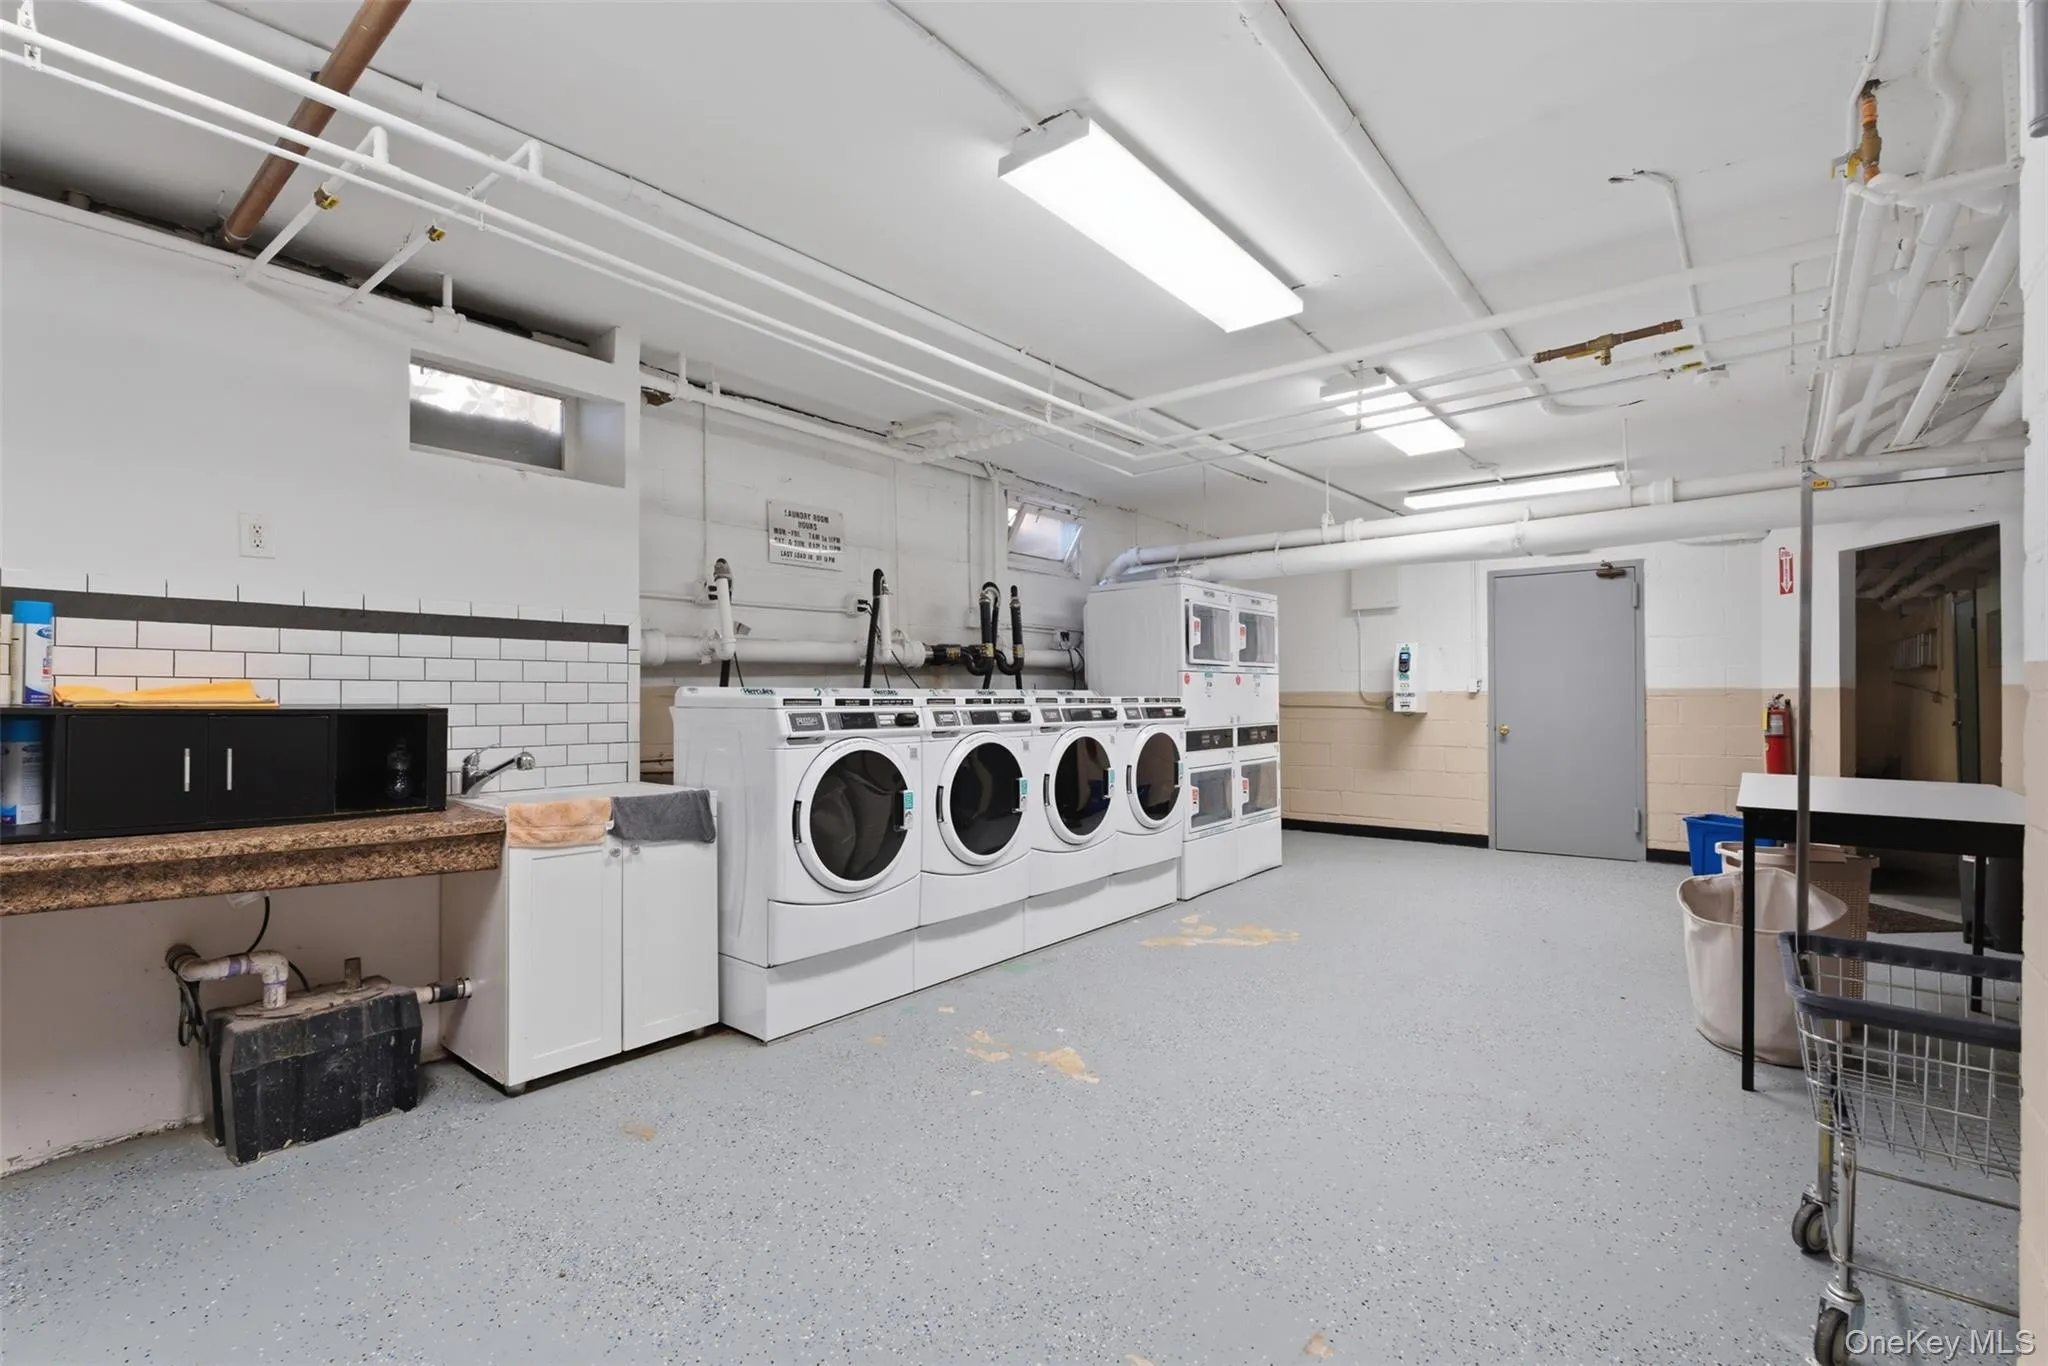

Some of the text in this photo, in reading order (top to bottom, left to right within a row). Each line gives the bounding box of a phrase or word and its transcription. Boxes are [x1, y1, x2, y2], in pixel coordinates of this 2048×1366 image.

[784, 509, 829, 524] LAUNDRY ROOM
[798, 521, 817, 531] HOURS
